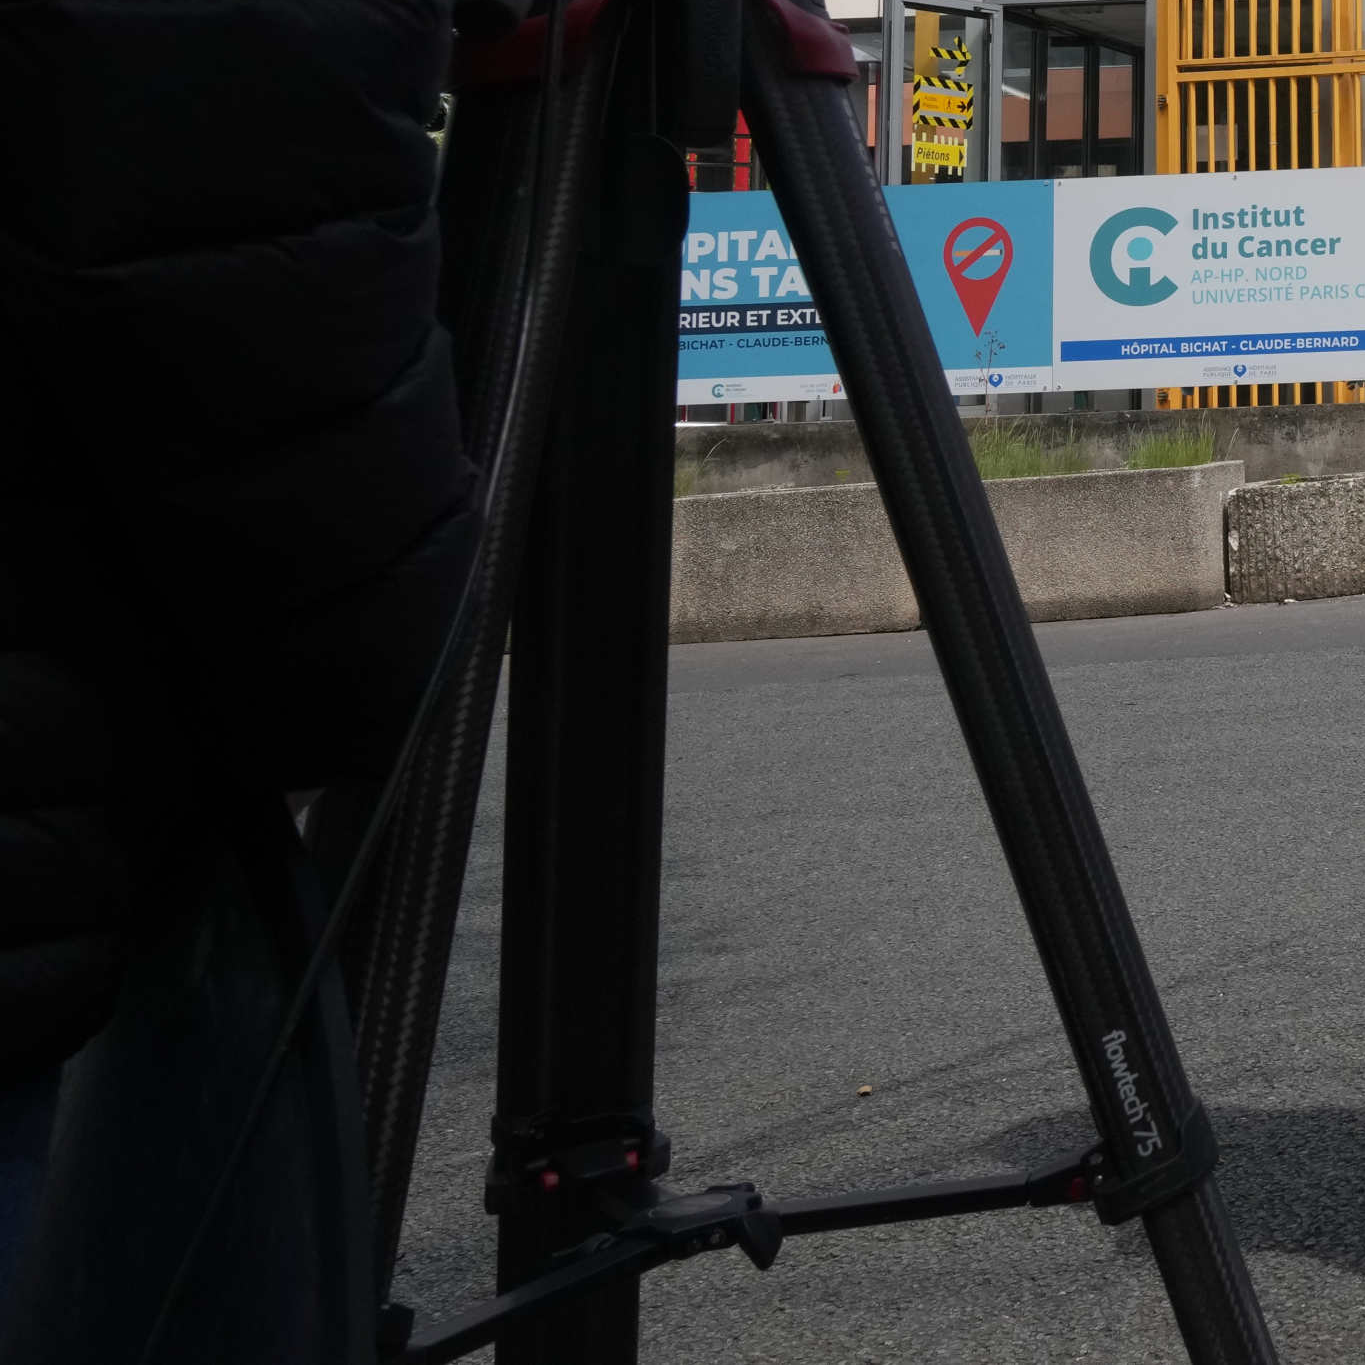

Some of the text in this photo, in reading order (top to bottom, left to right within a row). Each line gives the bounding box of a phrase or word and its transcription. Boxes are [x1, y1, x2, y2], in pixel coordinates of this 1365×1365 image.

[916, 146, 950, 162] Piétons
[1192, 204, 1305, 230] Institut
[1191, 235, 1342, 260] du Cancer
[1190, 265, 1308, 284] AP-HP. NORD
[1191, 283, 1293, 305] UNIVERSITÉ
[1300, 283, 1350, 301] PARIS
[746, 310, 771, 326] ET
[1121, 341, 1176, 356] HÔPITAL
[1180, 340, 1228, 354] BICHAT
[1239, 336, 1359, 352] CLAUDE-BERNARD
